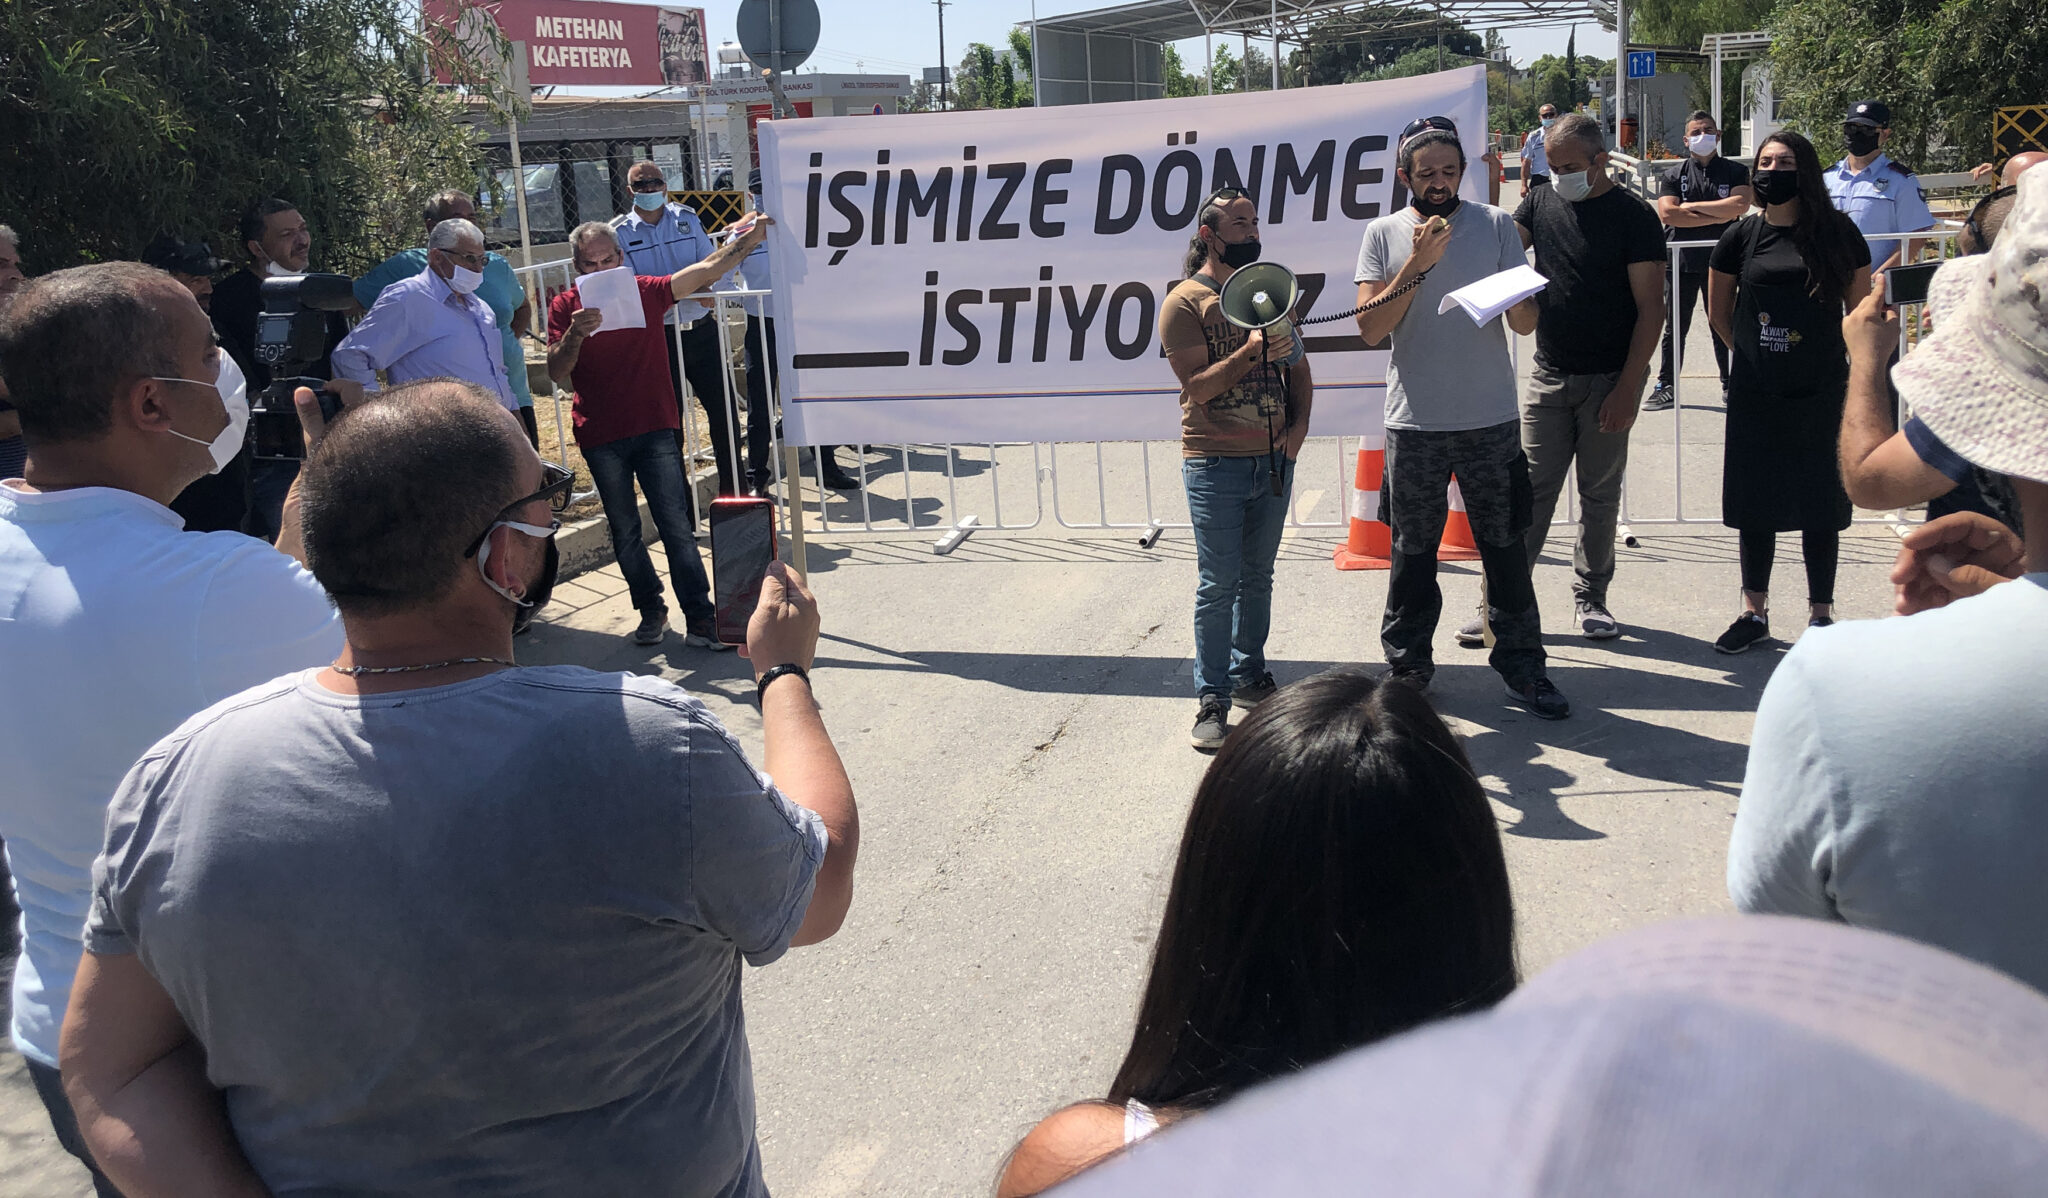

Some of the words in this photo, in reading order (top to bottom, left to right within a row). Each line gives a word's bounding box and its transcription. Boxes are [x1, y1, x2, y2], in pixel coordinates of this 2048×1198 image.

[536, 16, 624, 41] METEHAN
[532, 45, 633, 69] KAFETERYA
[739, 84, 774, 95] KOOPERA
[783, 82, 814, 92] BANKASI
[804, 145, 1074, 266] İŞİMİZE
[1093, 130, 1414, 236] DÖNME
[1680, 175, 1688, 201] POL
[1760, 326, 1790, 338] ALWAYS
[1770, 342, 1790, 353] LOVE
